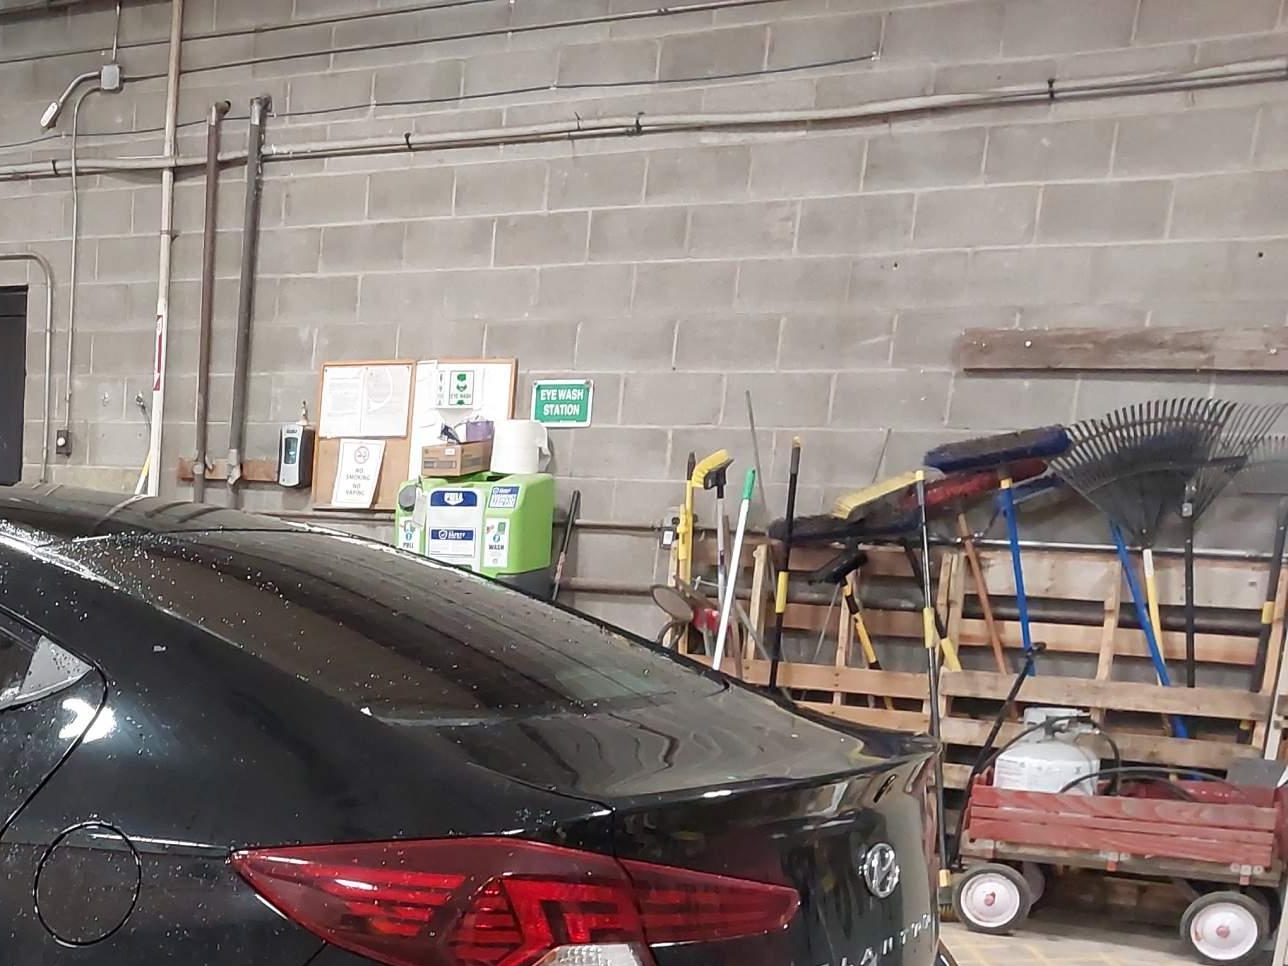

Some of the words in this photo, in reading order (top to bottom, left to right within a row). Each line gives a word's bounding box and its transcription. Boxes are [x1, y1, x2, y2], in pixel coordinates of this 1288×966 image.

[540, 388, 558, 401] EYE
[558, 388, 585, 401] WASH
[543, 403, 581, 416] STATION
